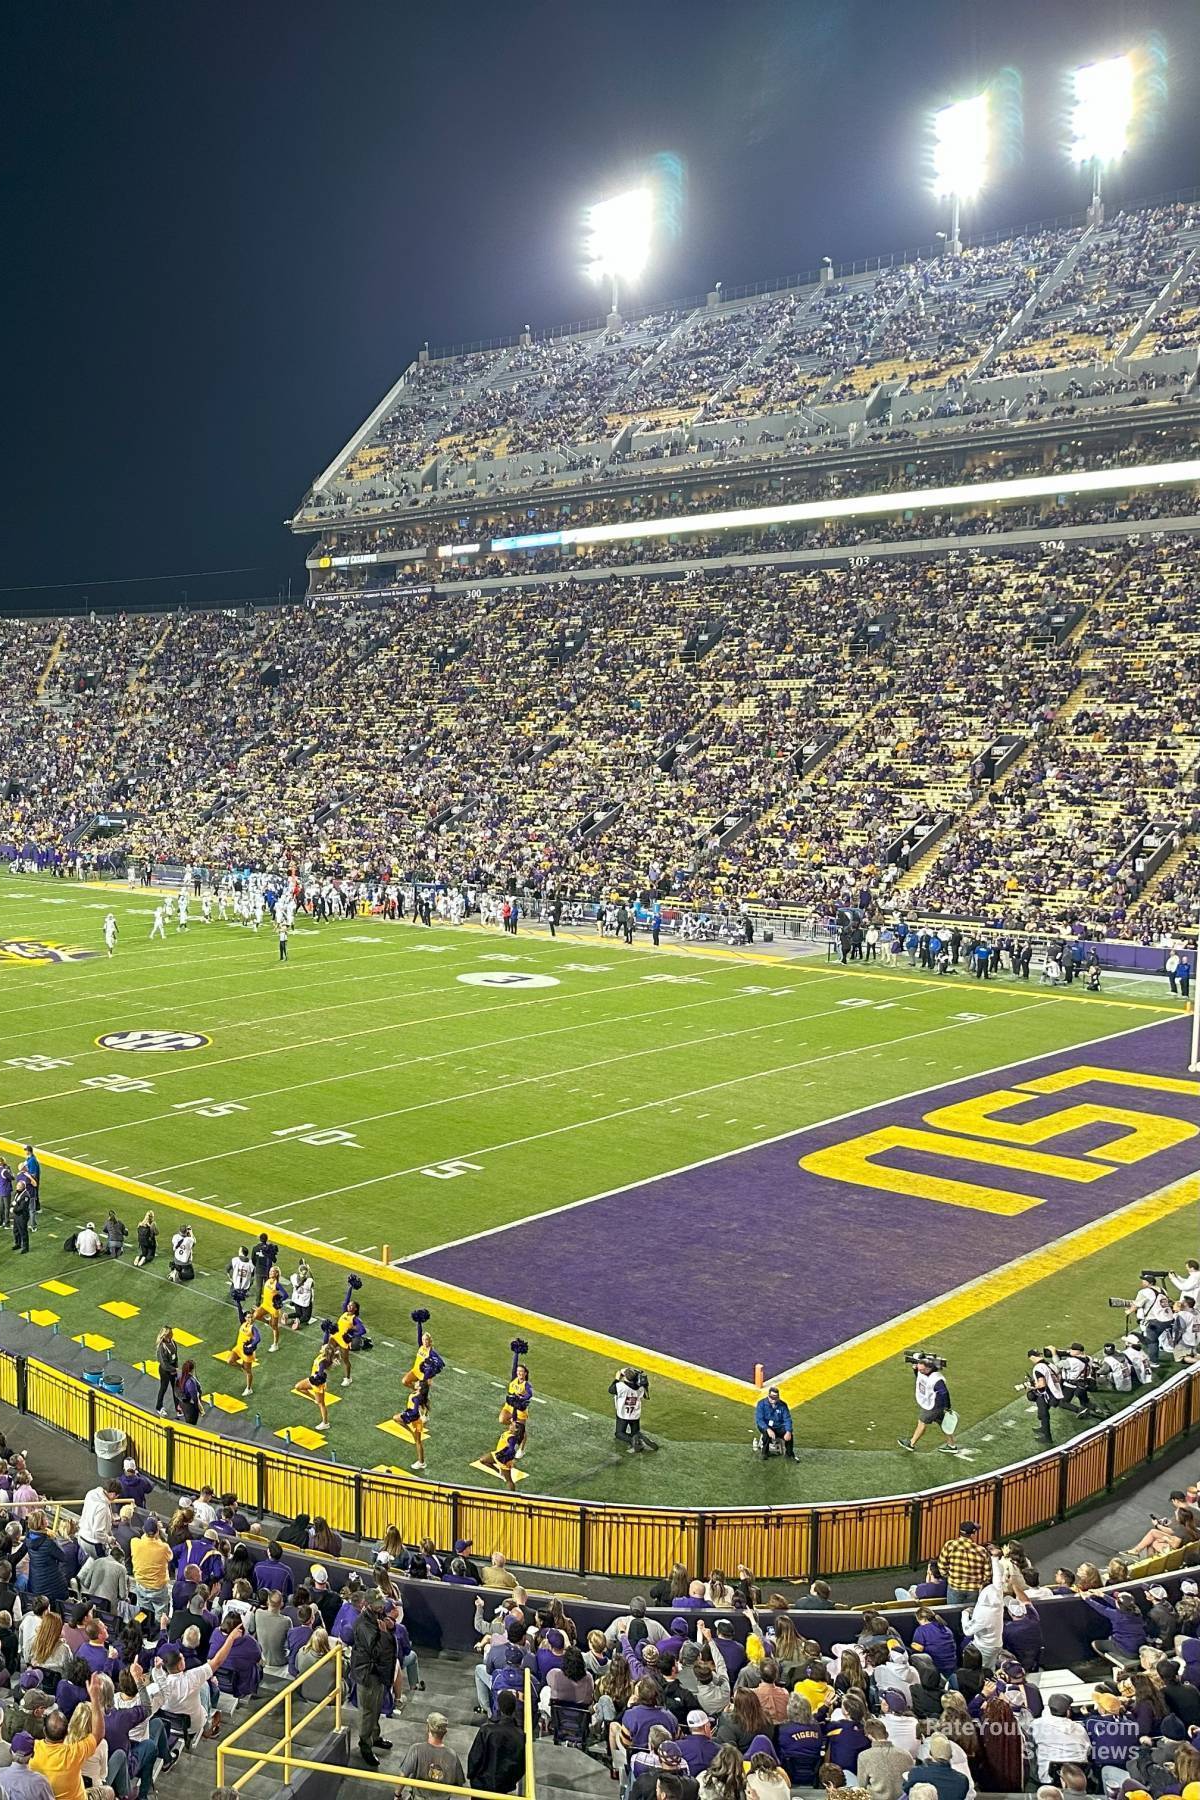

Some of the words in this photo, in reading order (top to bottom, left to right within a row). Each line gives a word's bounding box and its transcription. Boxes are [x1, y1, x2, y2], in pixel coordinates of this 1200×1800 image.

[1039, 541, 1065, 551] 304
[466, 590, 482, 599] 300
[836, 998, 898, 1010] 10
[104, 1031, 201, 1051] SEC
[3, 1054, 74, 1071] 25
[78, 1074, 155, 1092] 20
[171, 1098, 250, 1117] 15
[271, 1123, 357, 1146] 10
[798, 1065, 1200, 1217] LSU
[420, 1161, 485, 1179] 5
[792, 1731, 818, 1740] TIGERS
